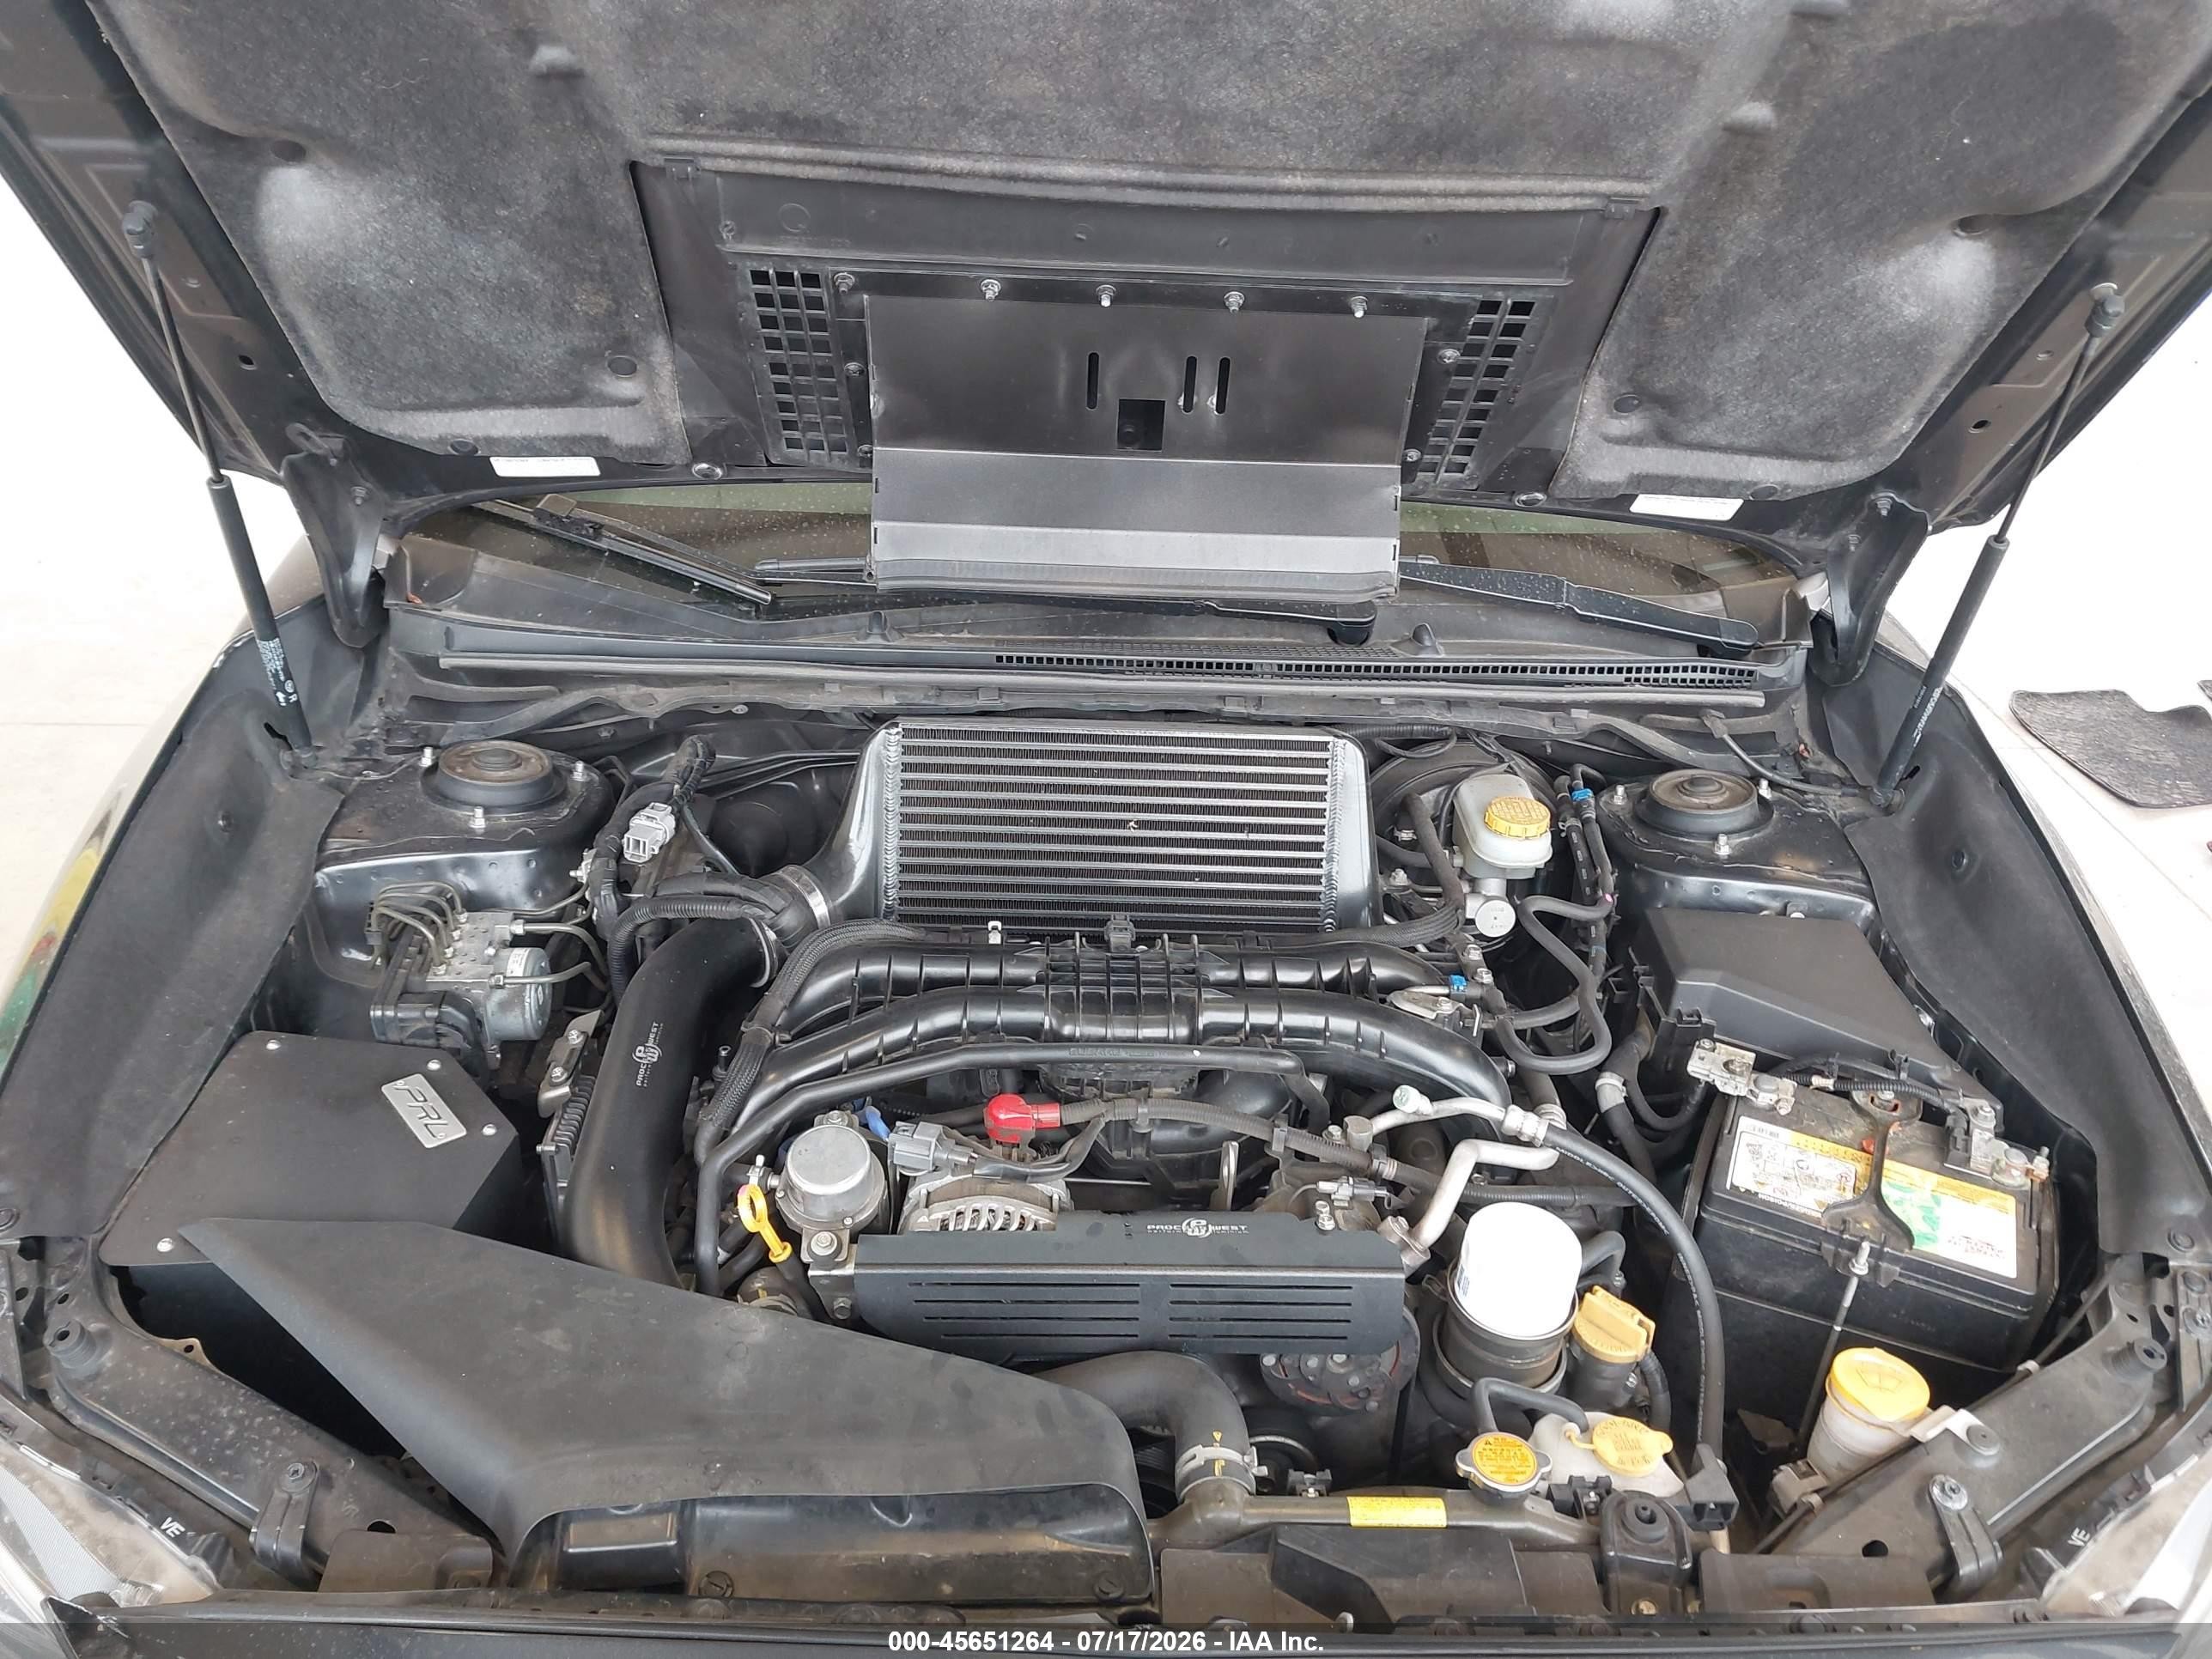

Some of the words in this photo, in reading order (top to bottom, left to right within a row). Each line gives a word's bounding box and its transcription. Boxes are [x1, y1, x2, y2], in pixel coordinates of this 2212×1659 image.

[392, 1085, 449, 1139] PRL
[160, 1516, 185, 1538] VE
[2067, 1527, 2091, 1547] VE
